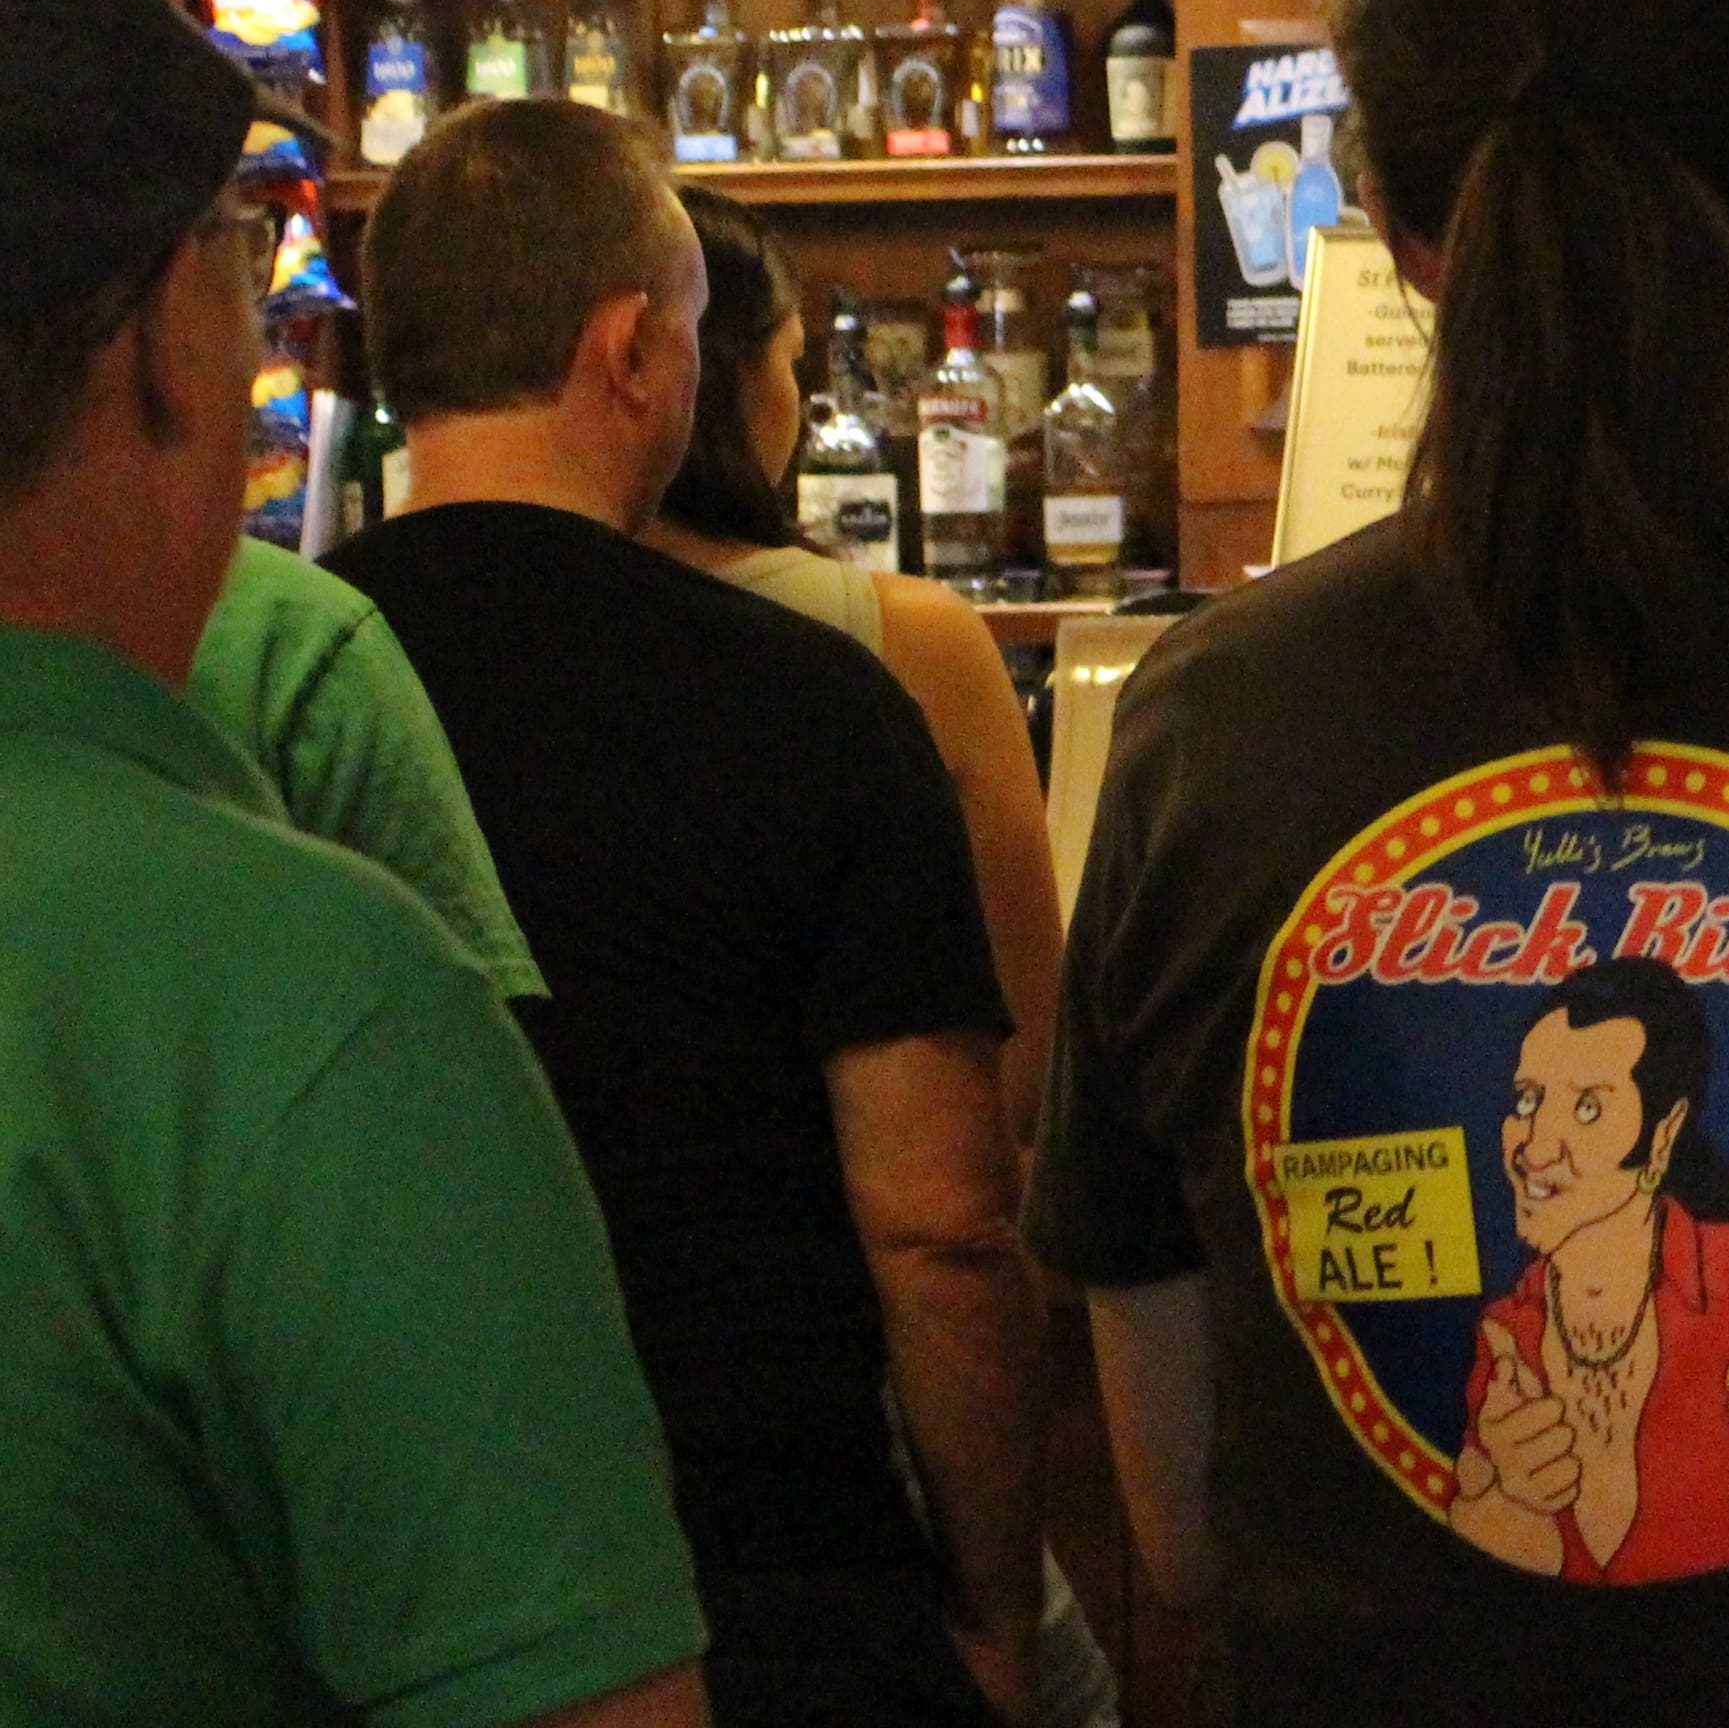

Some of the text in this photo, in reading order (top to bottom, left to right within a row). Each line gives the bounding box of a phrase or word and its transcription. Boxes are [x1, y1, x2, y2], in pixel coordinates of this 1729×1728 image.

[1308, 881, 1598, 985] Slick
[1282, 1139, 1449, 1181] RAMPAGING
[1324, 1185, 1416, 1235] Red
[1319, 1242, 1404, 1293] ALE
